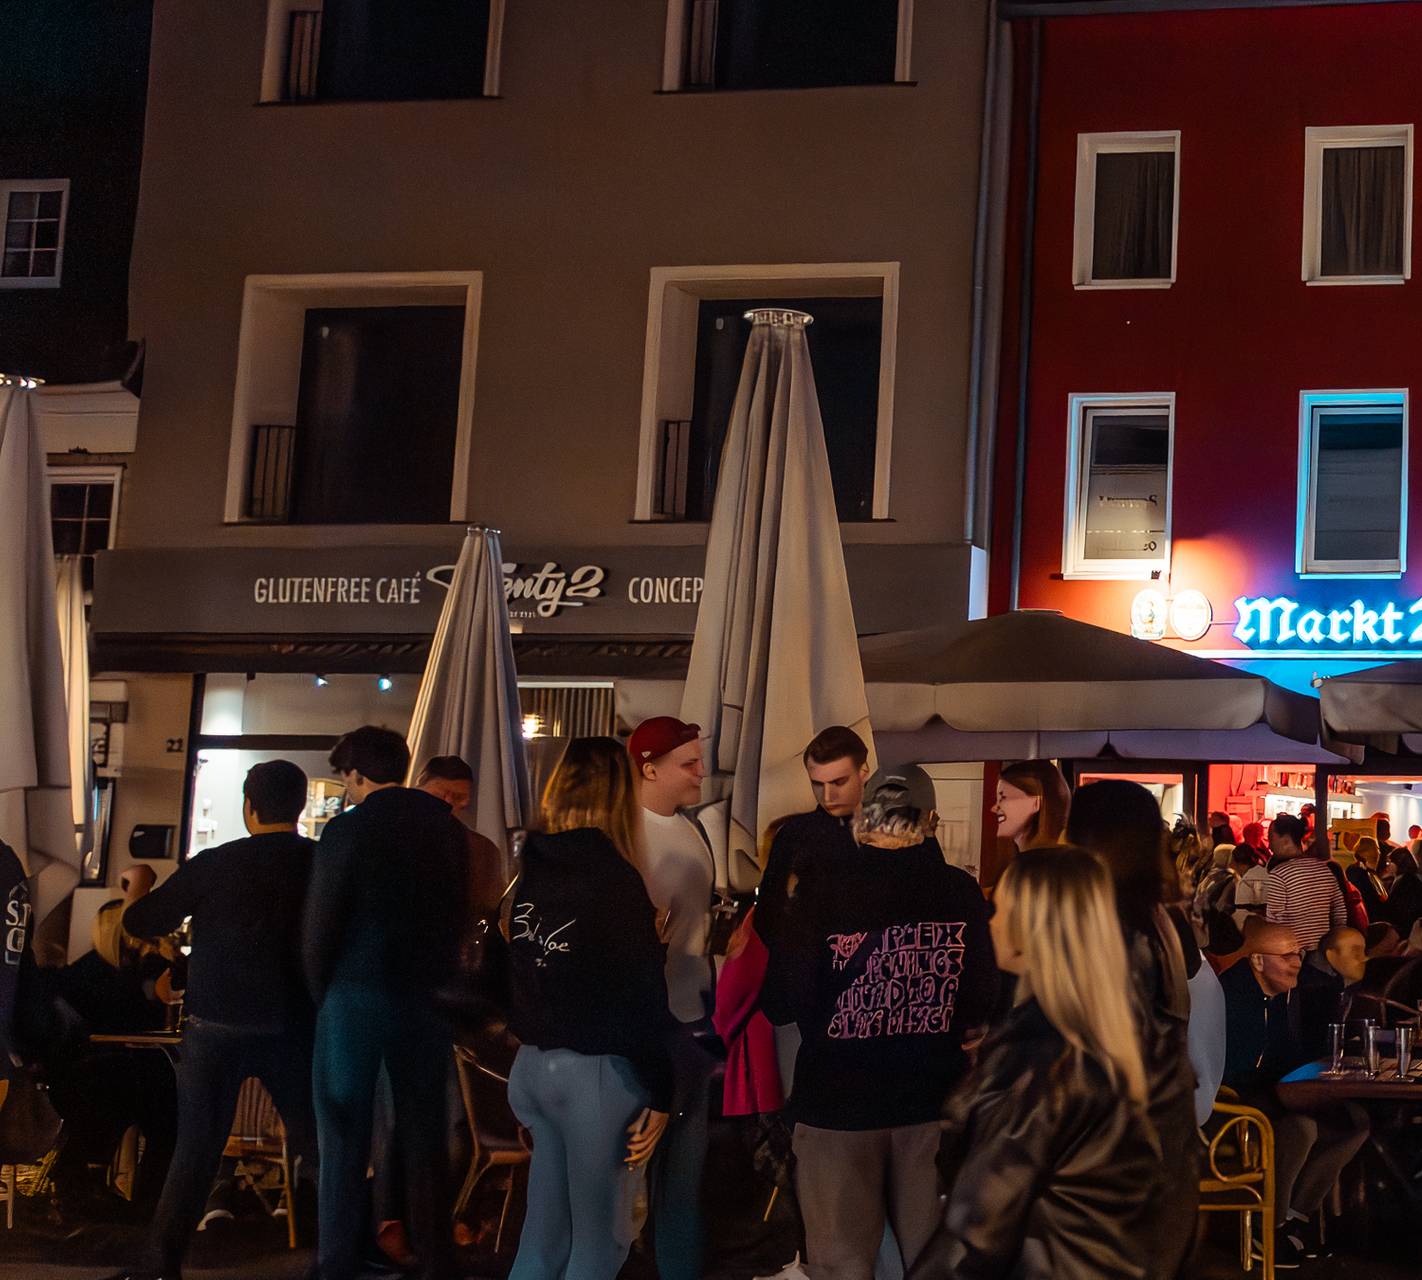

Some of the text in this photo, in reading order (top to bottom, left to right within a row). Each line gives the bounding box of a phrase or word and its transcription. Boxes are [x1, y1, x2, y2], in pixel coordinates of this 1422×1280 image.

[254, 577, 371, 603] GLUTENFREE
[376, 571, 421, 604] CAFÉ
[628, 576, 704, 603] CONCEP
[1232, 596, 1404, 644] Markt
